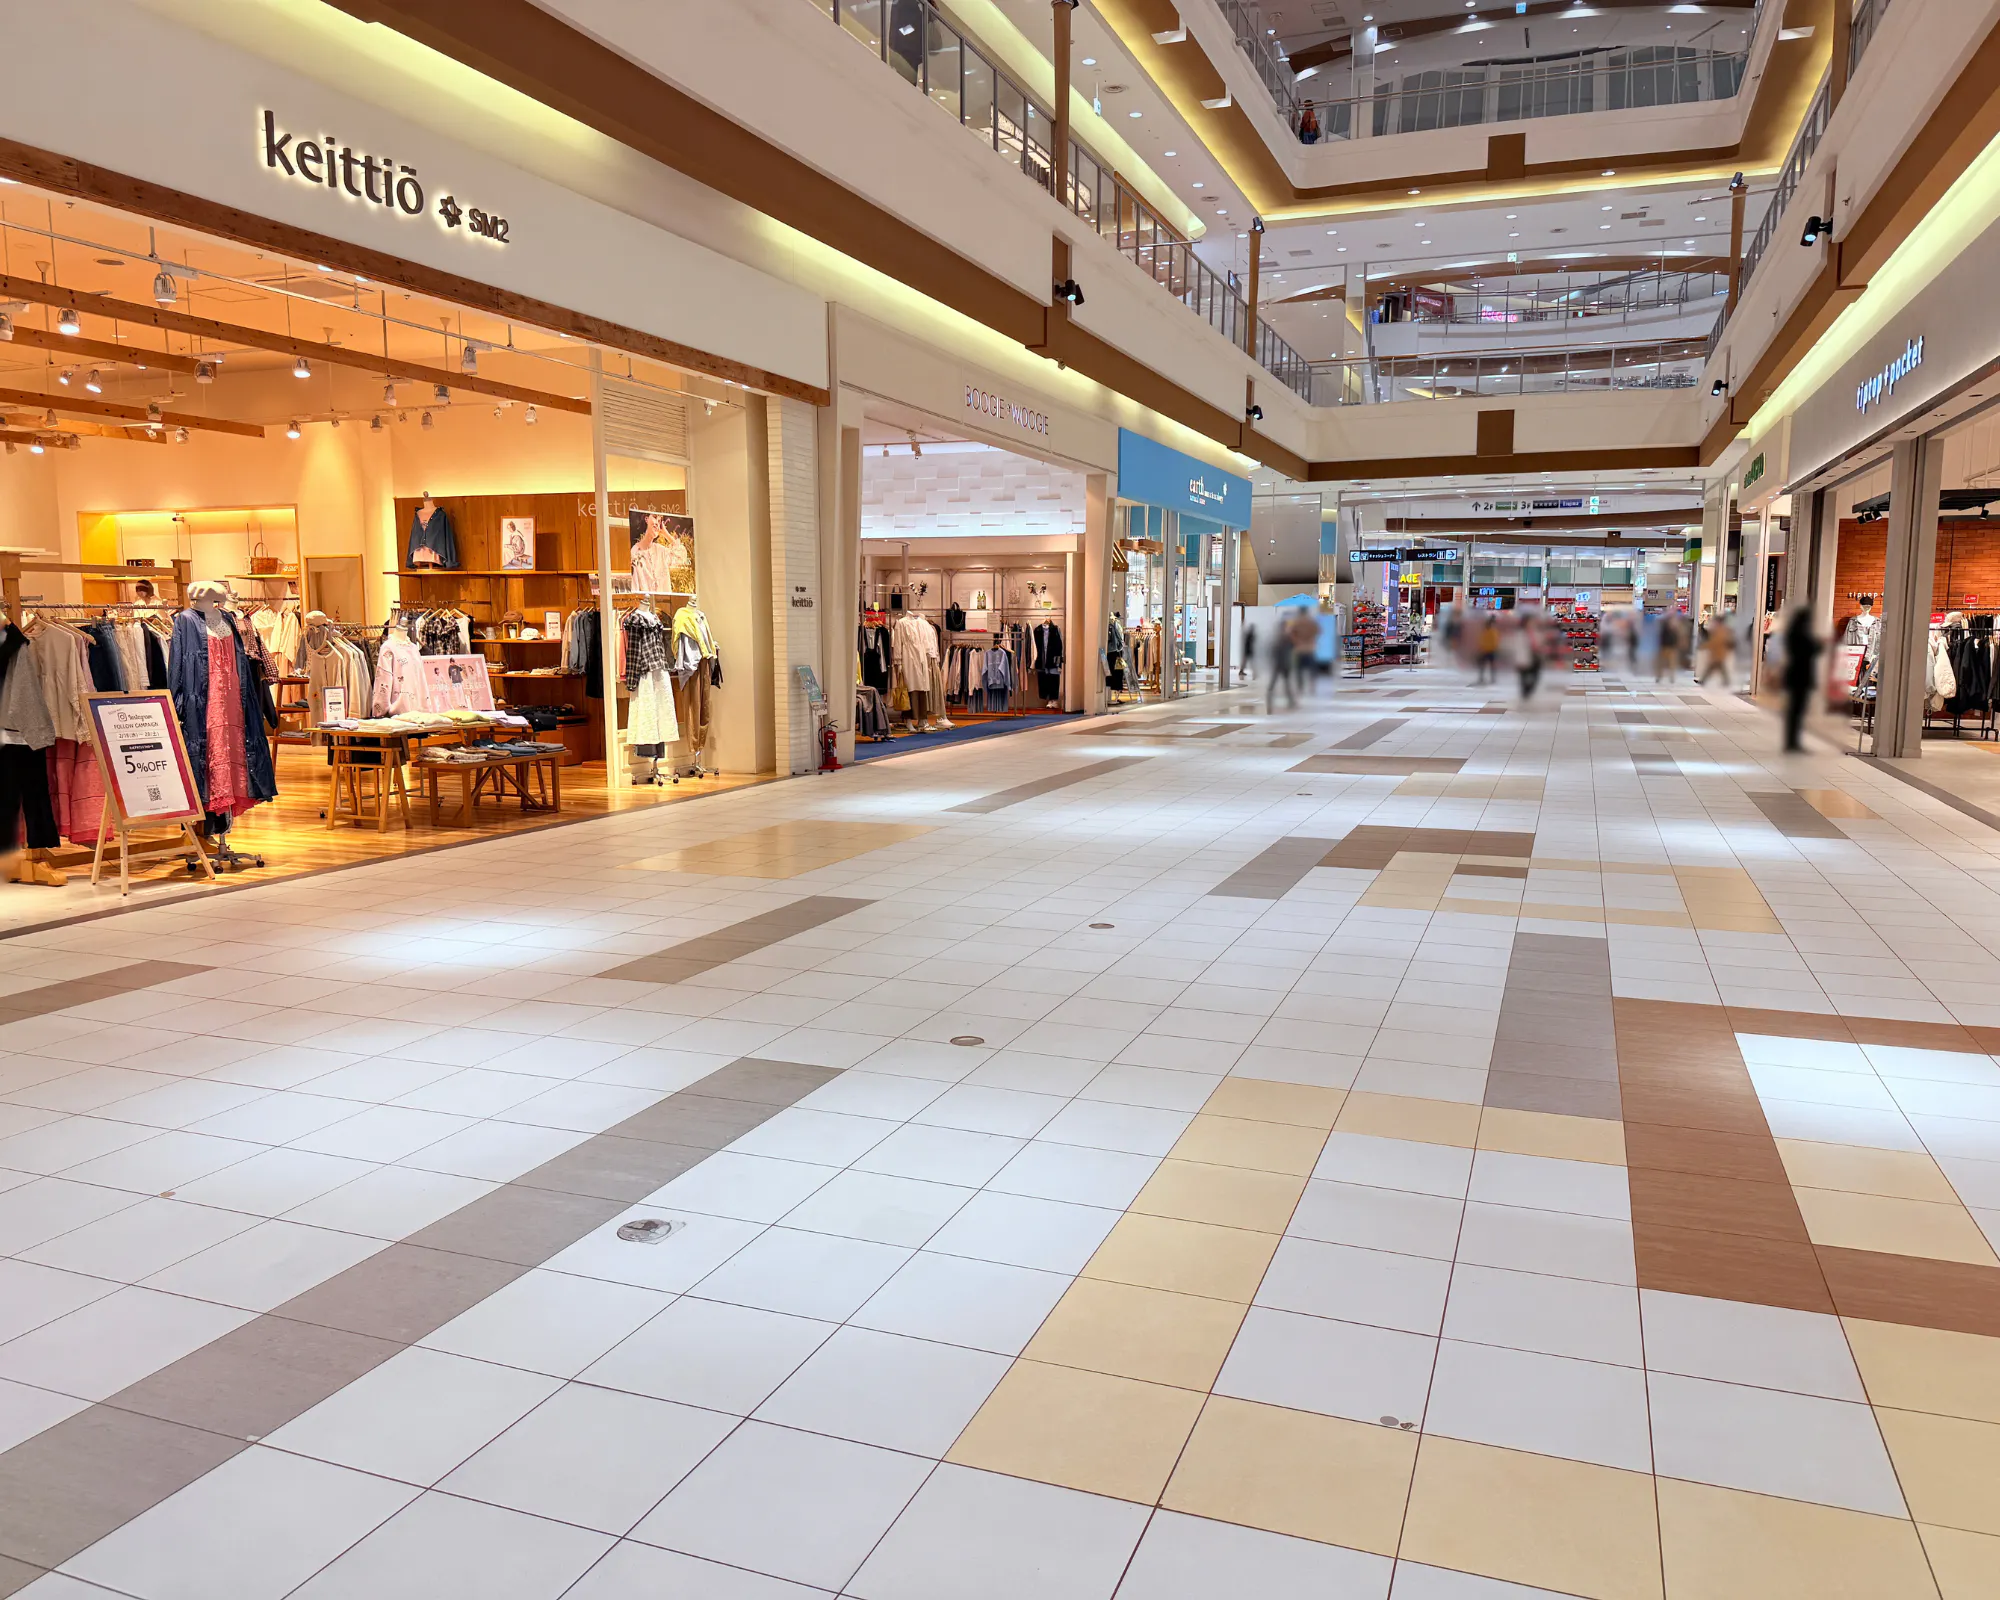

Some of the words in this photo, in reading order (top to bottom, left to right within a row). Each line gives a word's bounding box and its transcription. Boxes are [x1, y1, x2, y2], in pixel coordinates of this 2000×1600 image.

[468, 207, 509, 244] SM2
[1857, 373, 1883, 415] tiptop
[1889, 335, 1924, 396] pocket
[965, 384, 1005, 420] BOOGIE
[1011, 402, 1049, 436] WOOGIE
[1189, 475, 1204, 496] earth
[1483, 502, 1494, 511] 2F
[1520, 500, 1531, 509] 3F
